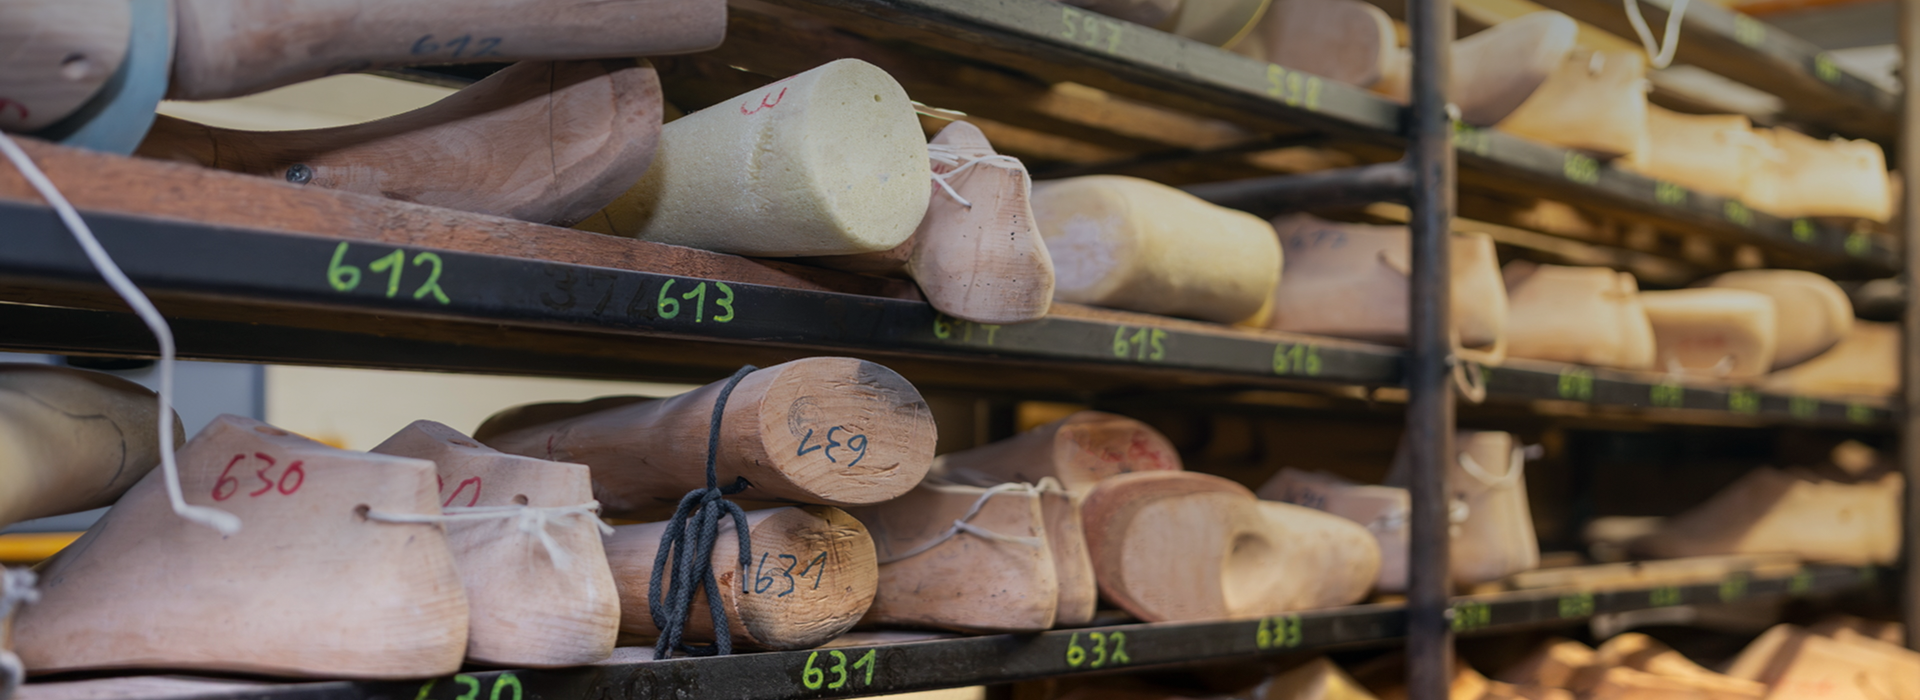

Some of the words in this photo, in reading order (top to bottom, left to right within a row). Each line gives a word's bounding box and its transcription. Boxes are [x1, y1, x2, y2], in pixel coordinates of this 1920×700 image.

[410, 33, 504, 58] 612
[1061, 6, 1121, 53] 597
[328, 241, 450, 305] 612
[654, 278, 736, 323] 613
[1113, 325, 1168, 362] 615
[1273, 343, 1322, 378] 616
[212, 452, 305, 502] 630
[753, 551, 829, 597] 631
[1065, 631, 1131, 667] 632
[1255, 616, 1303, 650] 633
[802, 648, 876, 690] 631
